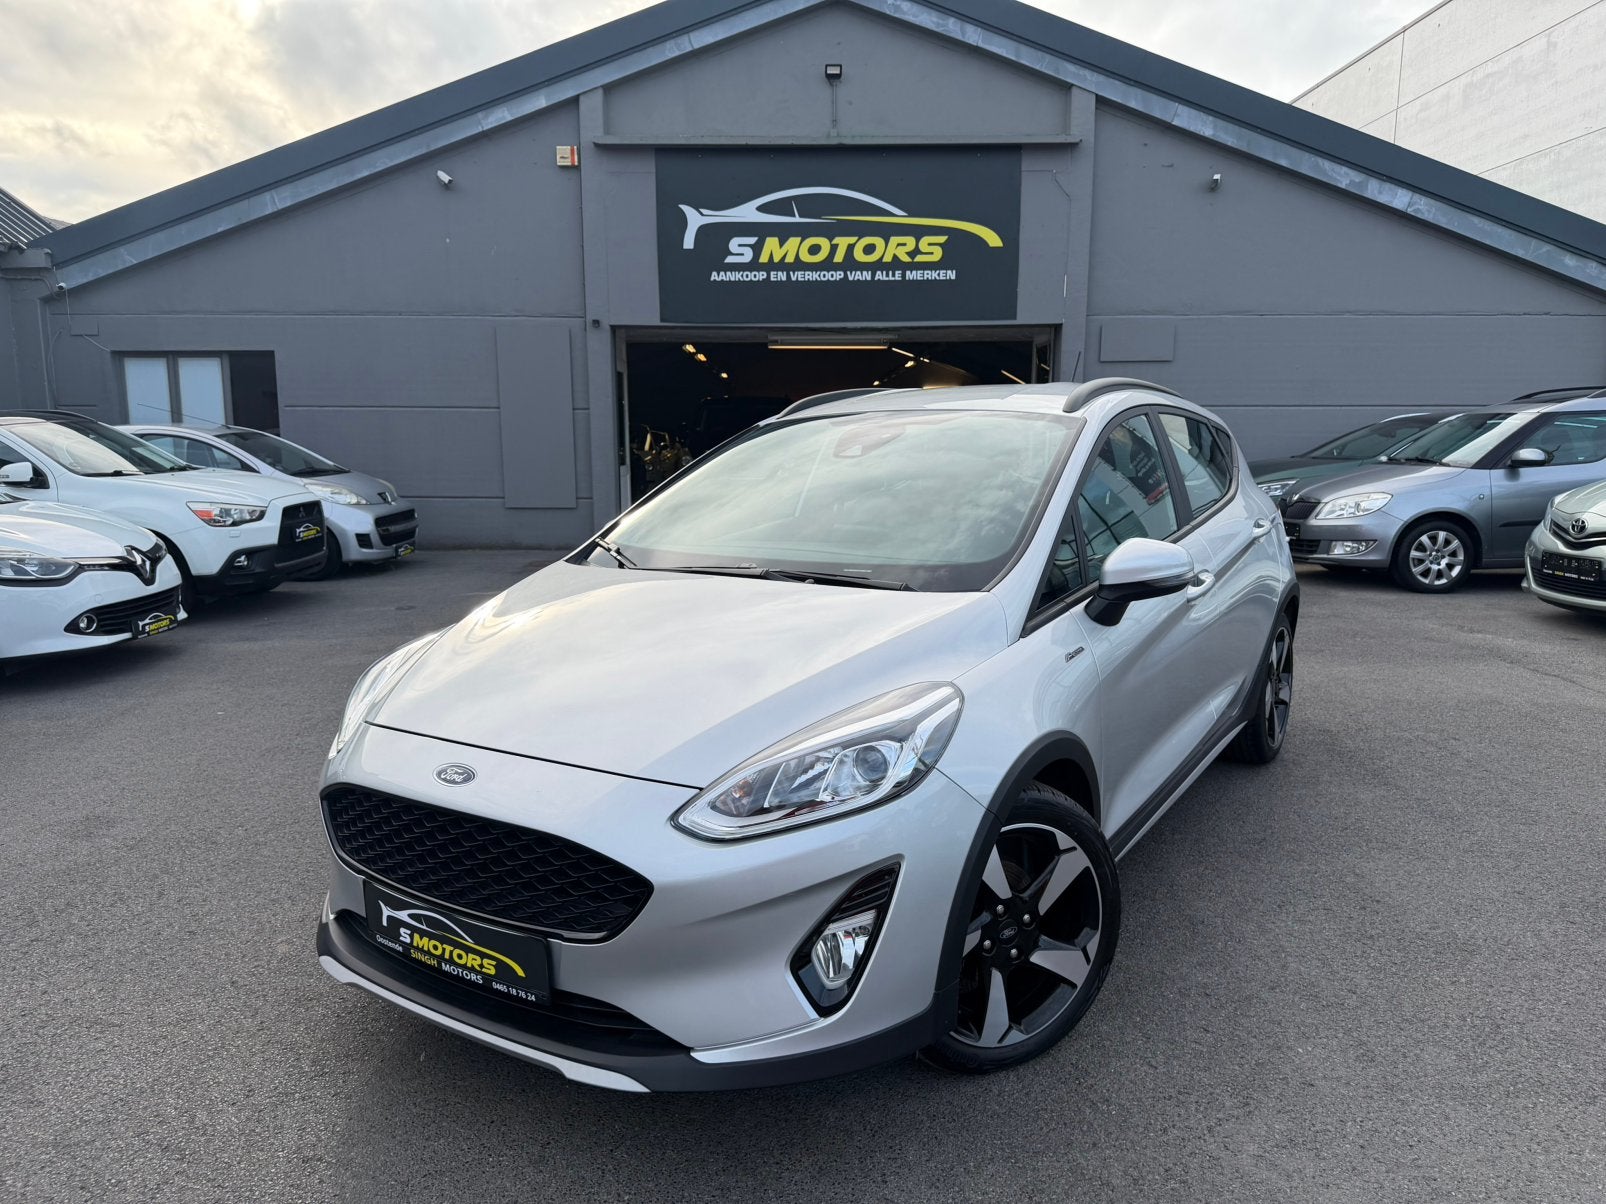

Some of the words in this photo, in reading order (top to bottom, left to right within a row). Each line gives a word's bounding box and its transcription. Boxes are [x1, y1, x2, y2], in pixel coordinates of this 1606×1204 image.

[724, 236, 759, 263] S
[759, 235, 949, 263] MOTORS
[710, 270, 767, 282] AANKOOP
[770, 270, 787, 281] EN
[790, 270, 845, 281] VERKOOP
[847, 270, 872, 281] VAN
[874, 270, 902, 281] ALLE
[905, 269, 956, 281] MERKEN
[149, 618, 170, 632] MOTORS
[440, 767, 468, 783] Ford
[399, 927, 411, 944] S
[413, 932, 497, 976] MOTORS
[410, 949, 438, 967] SINGH
[441, 962, 484, 985] MOTORS
